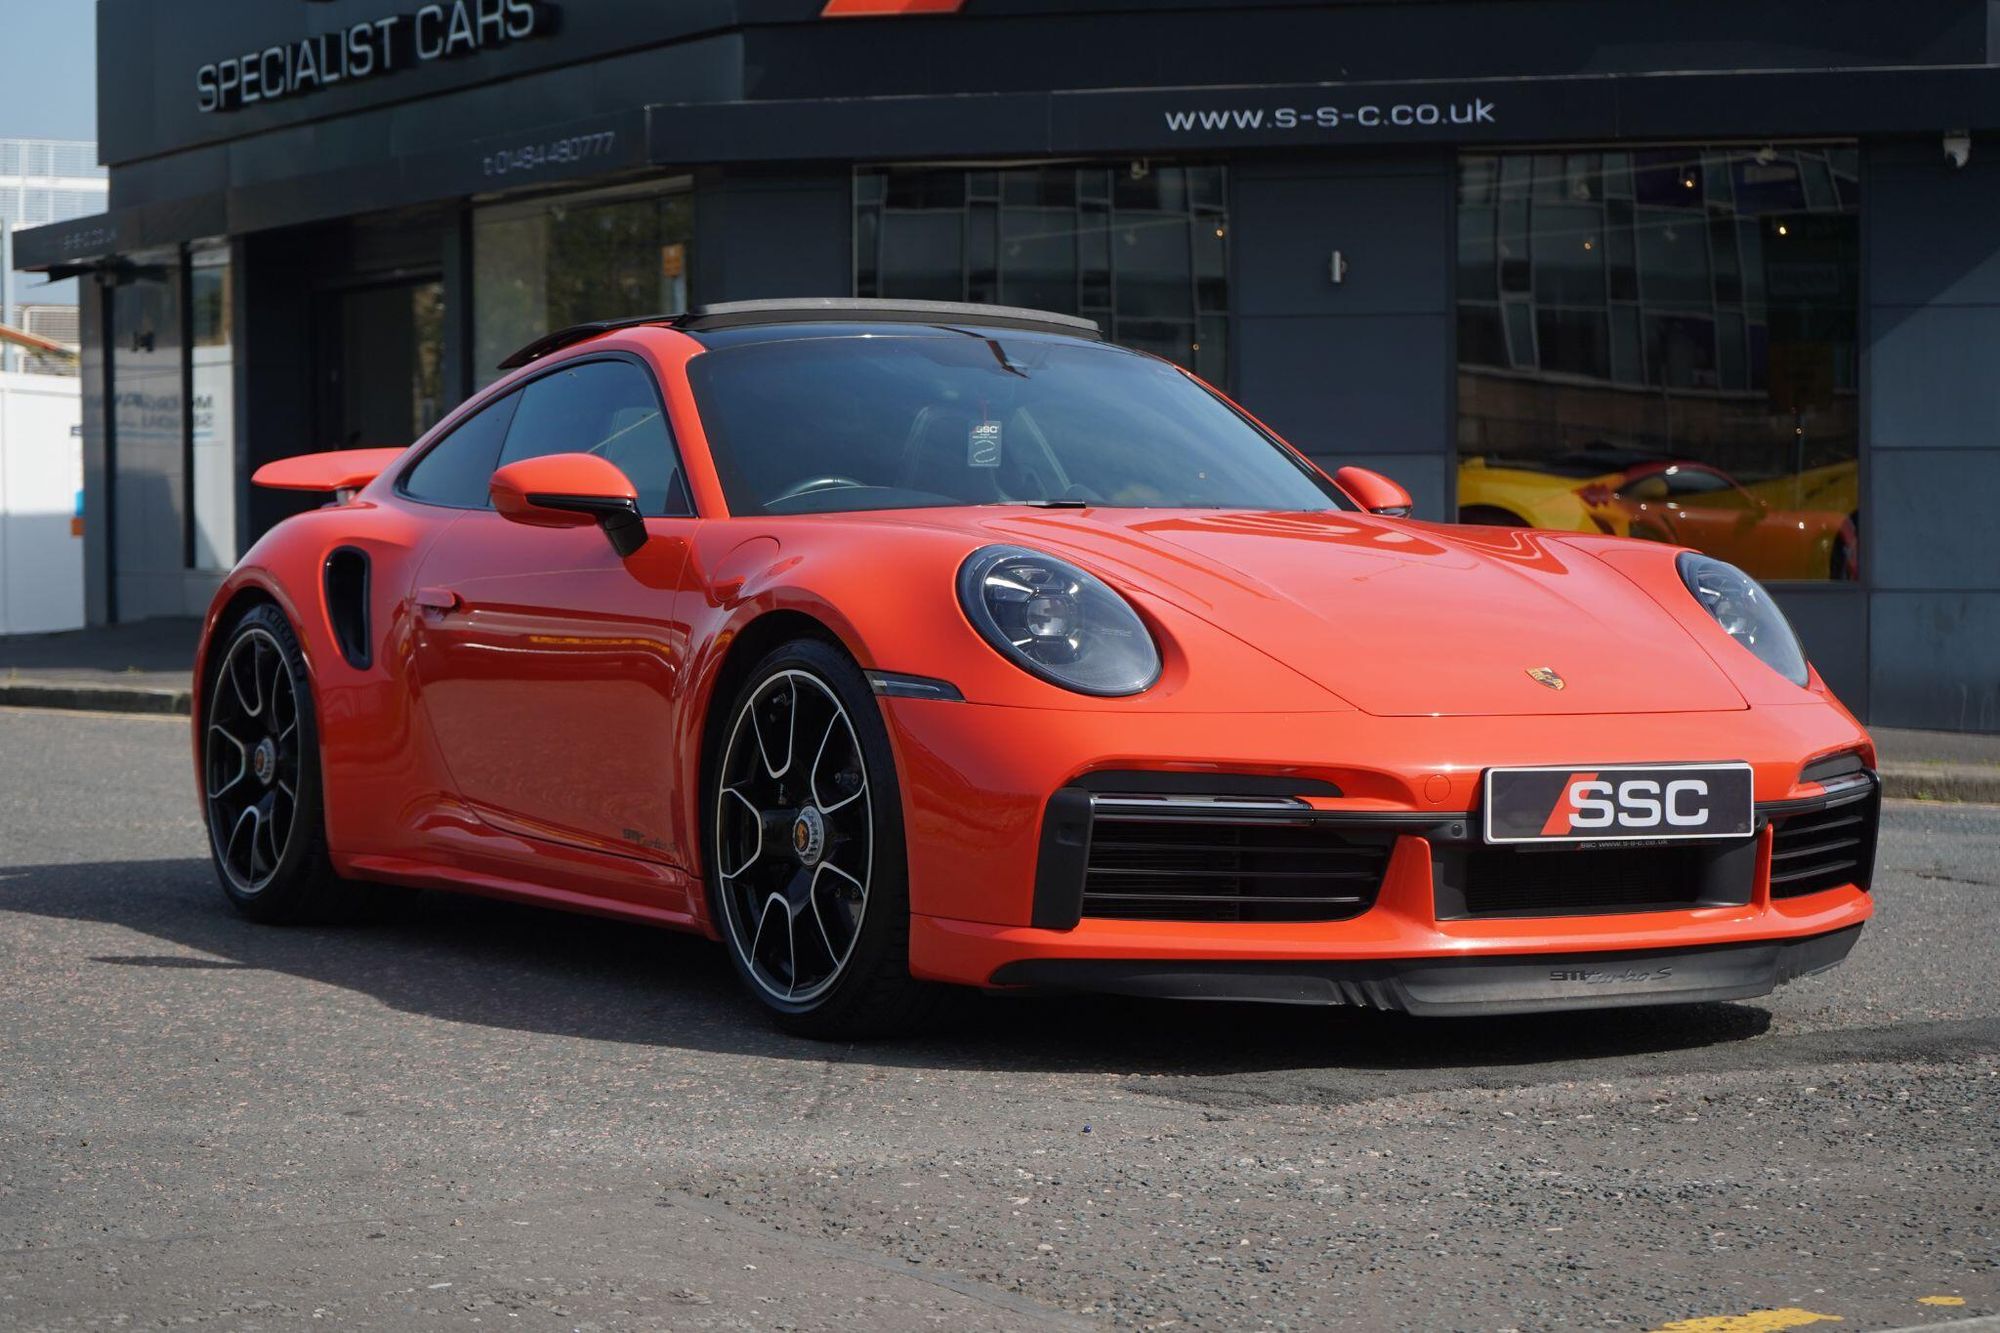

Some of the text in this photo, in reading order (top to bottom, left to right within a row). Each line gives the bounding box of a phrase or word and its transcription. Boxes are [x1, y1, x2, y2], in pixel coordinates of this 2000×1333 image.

[196, 0, 535, 113] SPECIALIST CARS
[1165, 98, 1496, 131] www.s-s-c.co.uk
[1568, 779, 1709, 828] SSC
